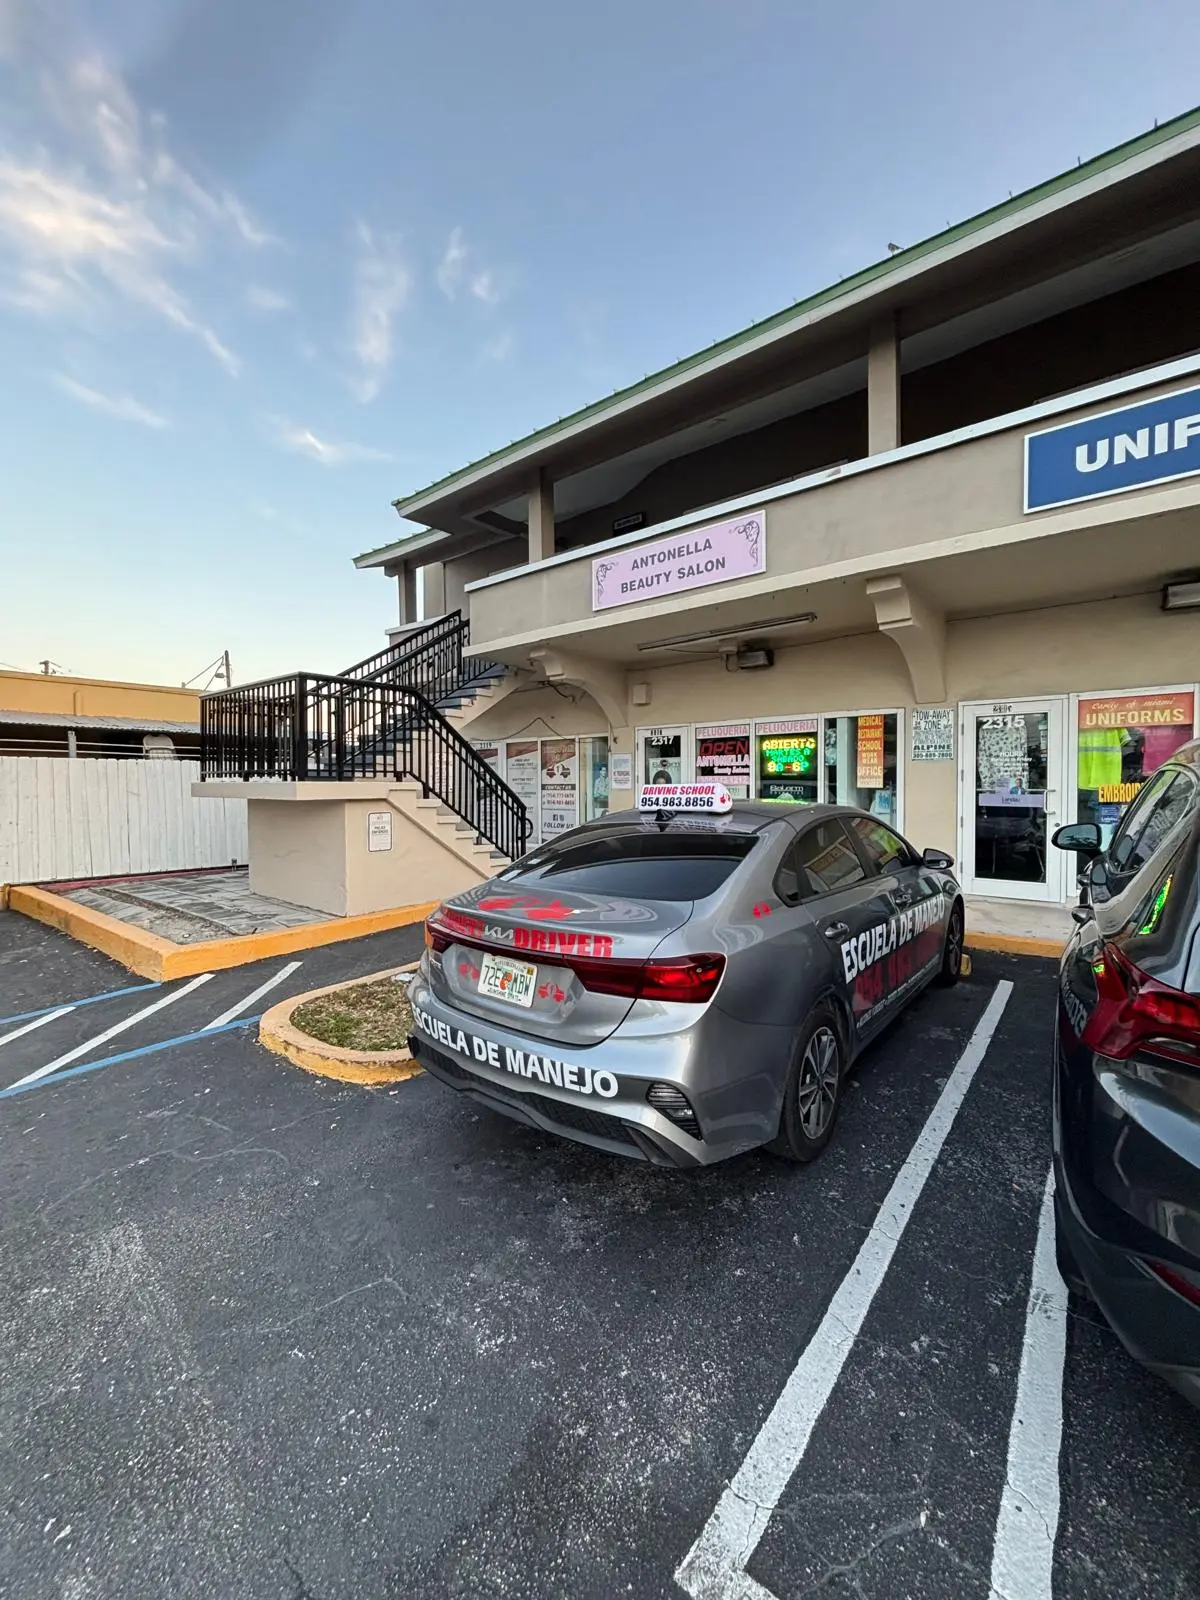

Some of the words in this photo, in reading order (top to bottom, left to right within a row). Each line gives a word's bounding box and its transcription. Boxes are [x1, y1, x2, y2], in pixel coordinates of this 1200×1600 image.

[1075, 414, 1200, 473] UNIF
[631, 538, 713, 571] ANTONELLA
[620, 570, 672, 594] BEAUTY
[677, 556, 726, 580] SALON
[858, 715, 882, 726] MEDICAL
[981, 714, 1026, 730] 2315
[1085, 708, 1185, 726] UNIFORMS
[757, 720, 816, 734] PELUQUERIA
[923, 719, 941, 730] ZONE
[651, 735, 674, 746] 2317
[762, 737, 816, 750] ABIERTO
[858, 740, 882, 751] SCHOOL
[913, 743, 953, 751] ALPINE
[700, 741, 749, 756] OPEN
[696, 754, 750, 767] ANTONELLA
[858, 766, 883, 776] OFFICE
[642, 786, 678, 796] DRIVING
[679, 785, 716, 795] SCHOOL
[640, 796, 714, 808] 954.983.8856
[566, 822, 574, 830] US
[513, 927, 614, 959] DRIVER
[840, 919, 897, 985] ESCUELA
[899, 909, 914, 947] DE
[411, 1001, 470, 1057] ESCUELA
[472, 1035, 501, 1069] DE
[505, 1047, 619, 1098] MANEJO
